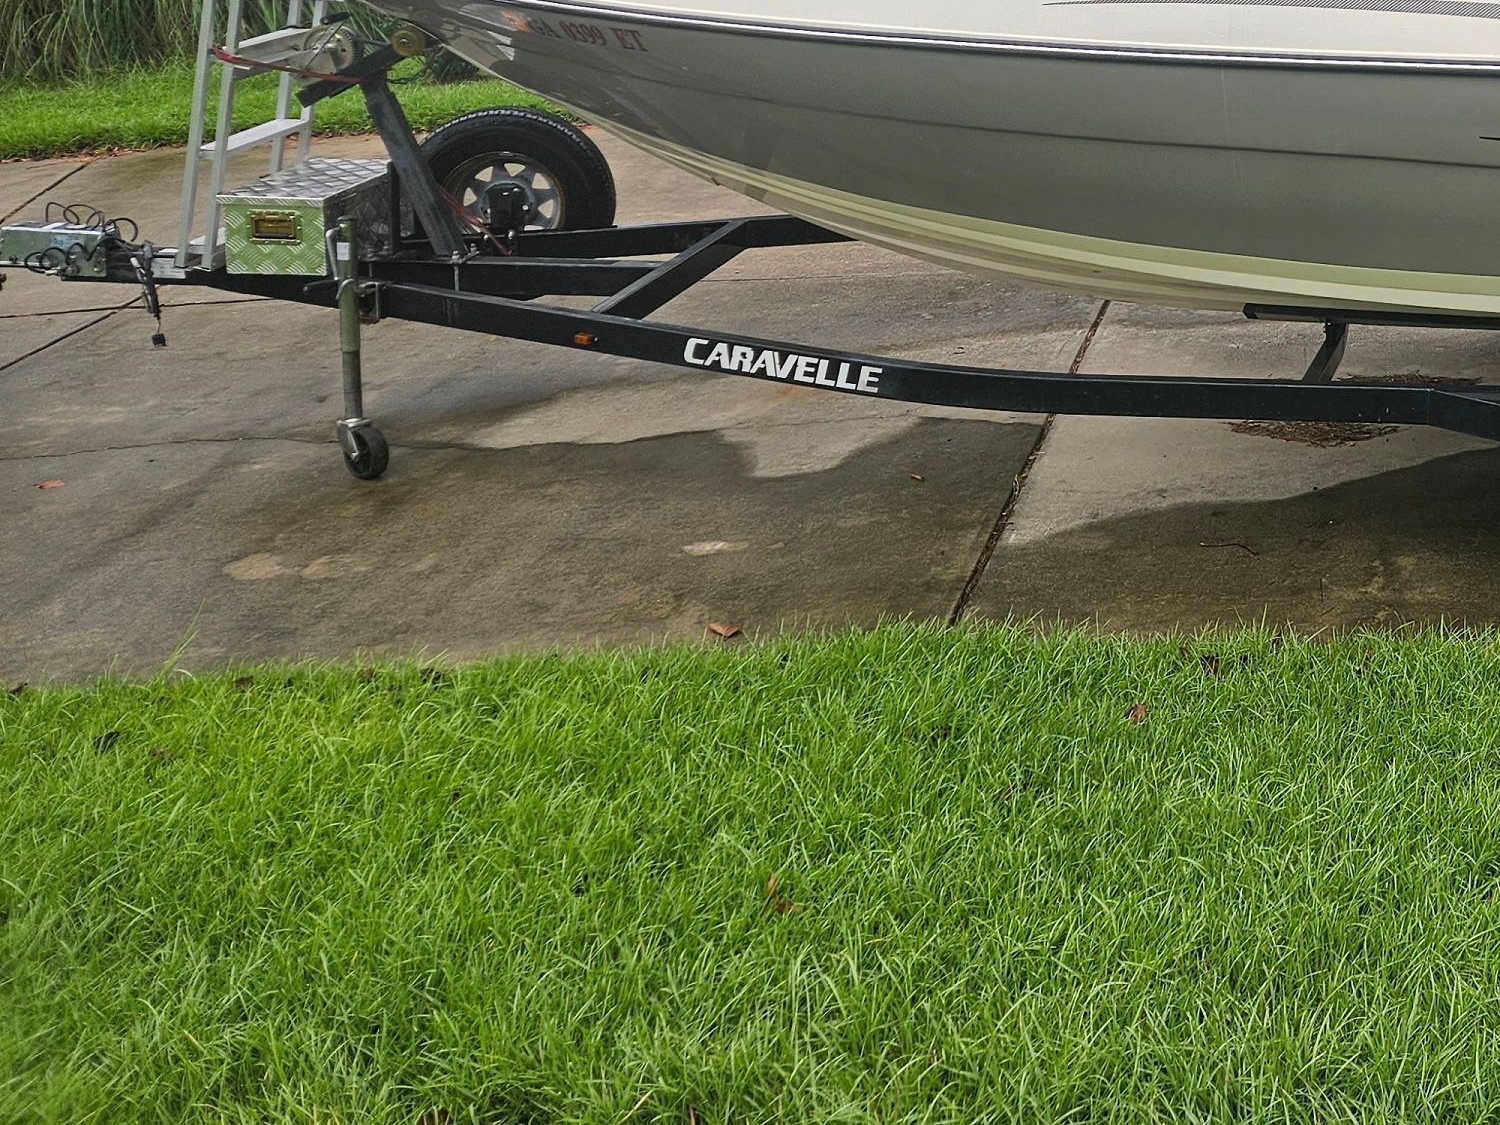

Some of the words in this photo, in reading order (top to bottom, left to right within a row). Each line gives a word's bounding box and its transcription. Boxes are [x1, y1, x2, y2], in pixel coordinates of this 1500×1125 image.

[558, 20, 607, 46] 0399
[609, 27, 649, 52] ET
[683, 337, 883, 393] CARAVELLE
